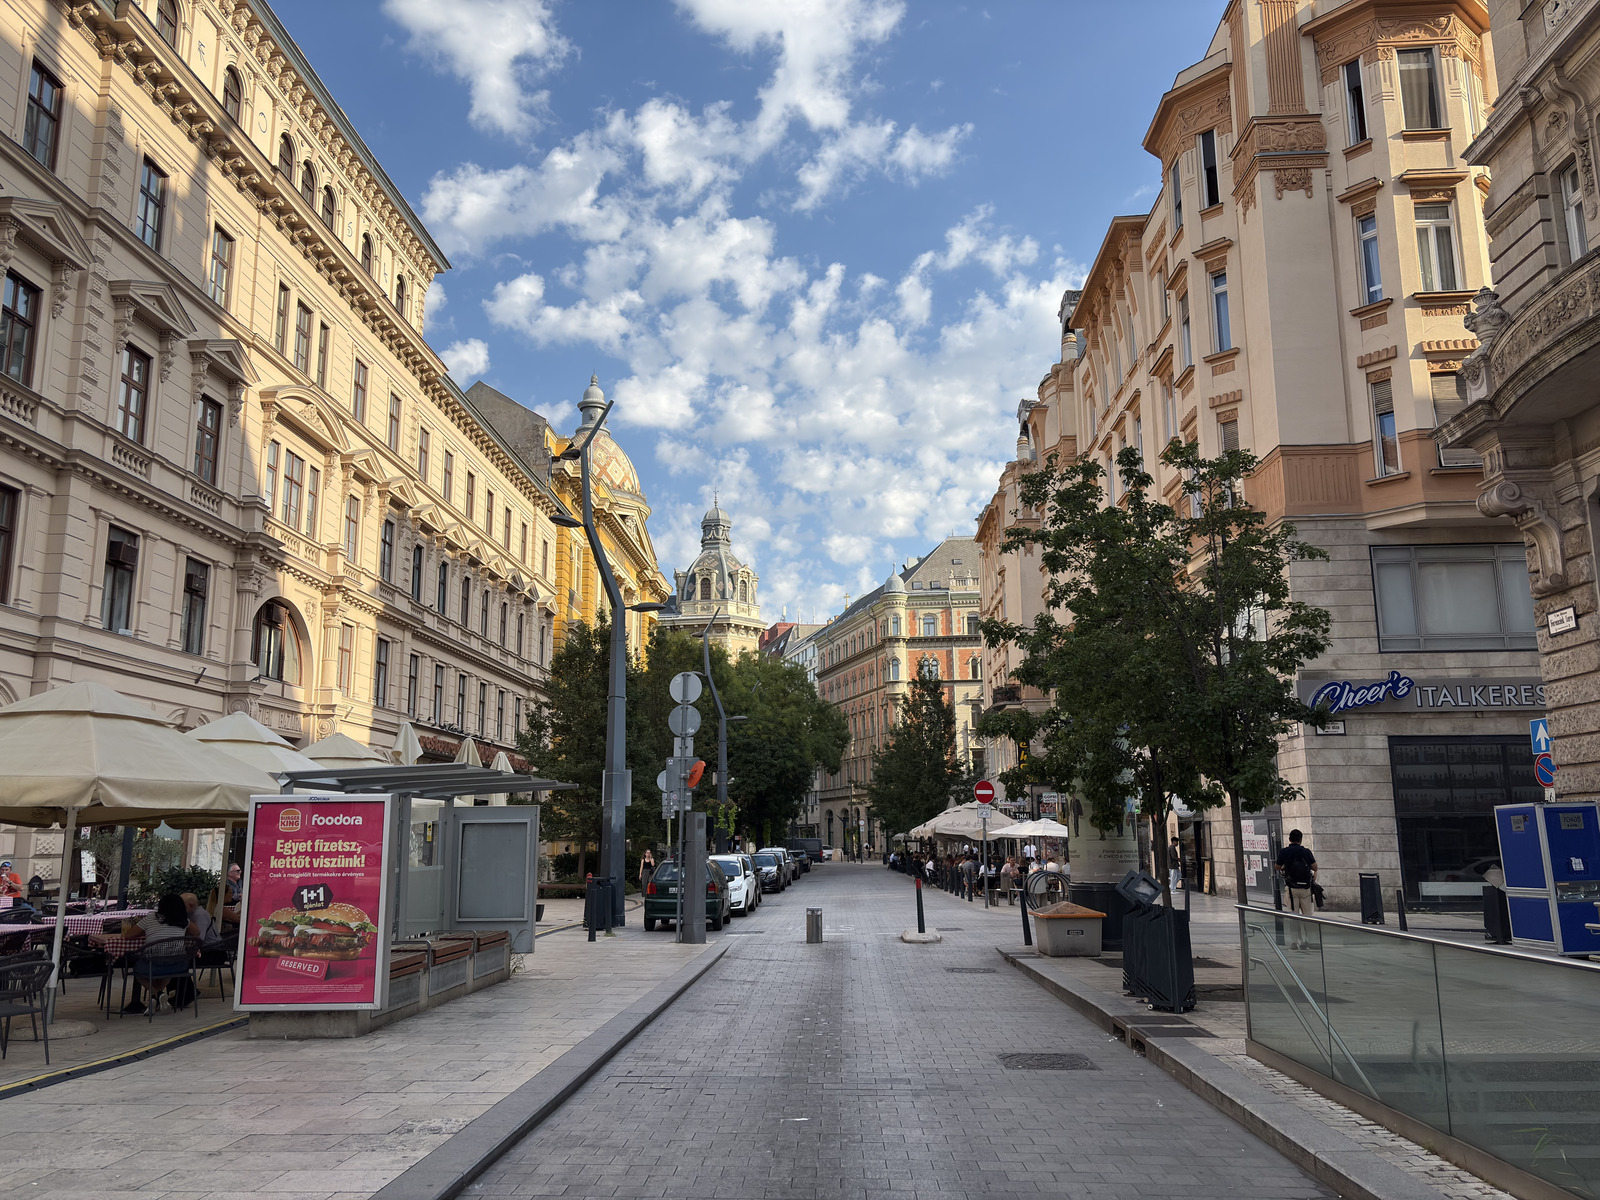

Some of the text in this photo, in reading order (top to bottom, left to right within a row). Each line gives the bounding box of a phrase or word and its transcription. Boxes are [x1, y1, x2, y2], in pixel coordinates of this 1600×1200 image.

[1311, 672, 1546, 714] Cheer's ITALKERES
[312, 814, 363, 825] foodora
[276, 839, 360, 855] Egyet fizetsz,
[270, 854, 366, 868] kettőt viszünk!
[300, 887, 324, 903] 1+1
[304, 902, 324, 910] ajánlat
[280, 959, 320, 973] RESERVED
